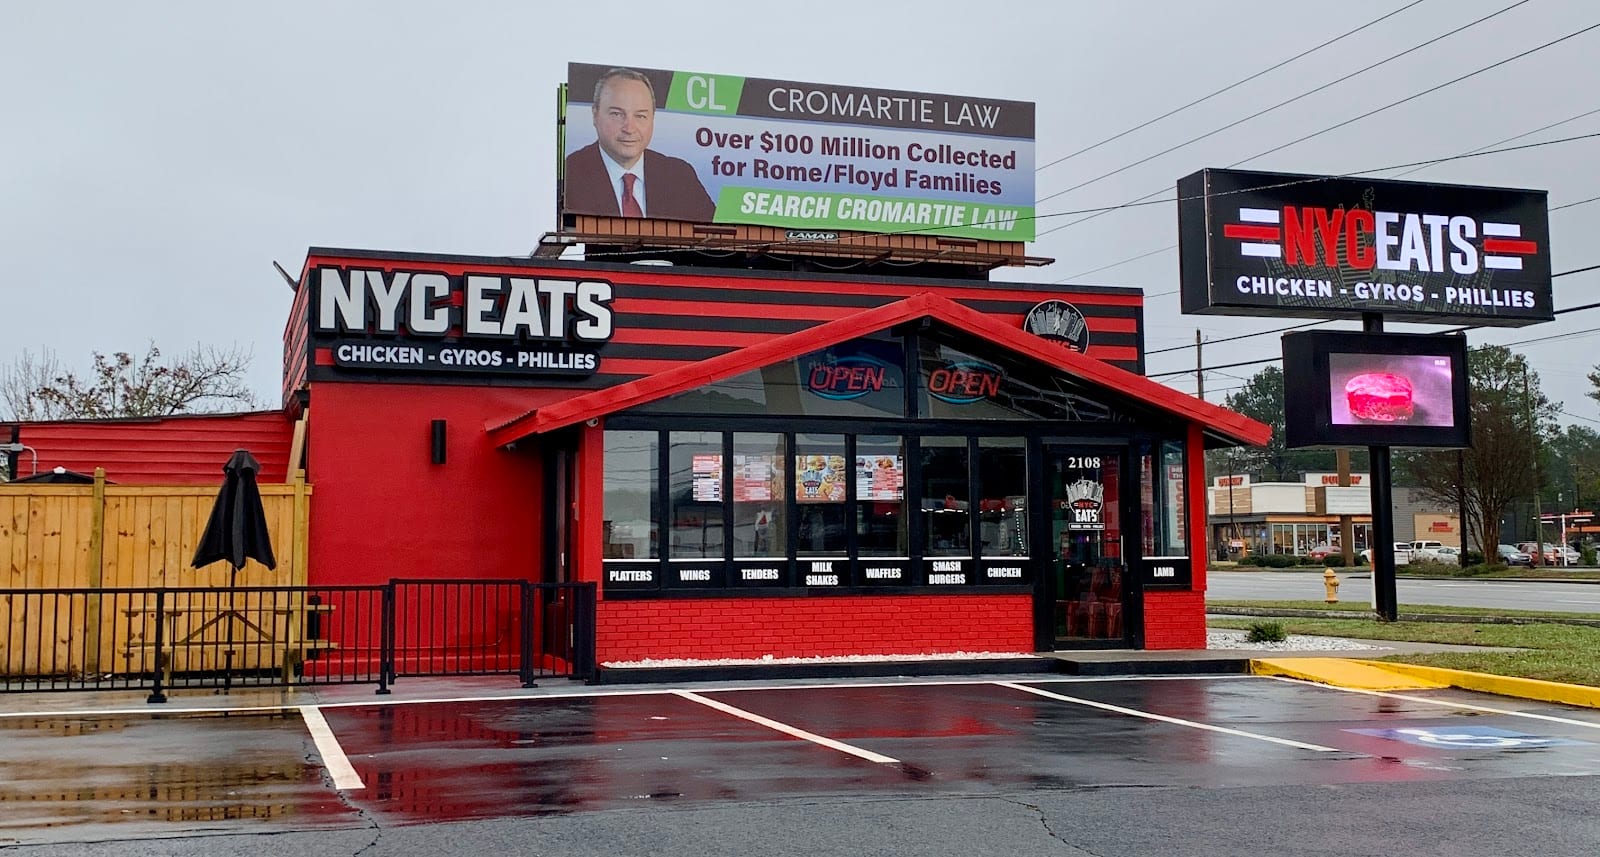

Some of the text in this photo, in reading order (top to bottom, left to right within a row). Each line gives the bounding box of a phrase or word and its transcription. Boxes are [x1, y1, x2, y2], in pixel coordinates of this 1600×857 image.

[686, 76, 727, 112] CL
[768, 87, 1001, 129] CROMARTIE LAW
[695, 126, 1017, 170] Over $100 Million Collected
[712, 154, 1002, 195] for Rome/Floyd Families
[741, 191, 1019, 231] SEARCH CROMARTIE LAW
[789, 232, 836, 241] LAMAR
[1236, 275, 1332, 298] CHICKEN
[1354, 282, 1425, 303] GYROS
[1446, 286, 1536, 308] PHILLIES
[318, 268, 613, 340] NYC EATS
[337, 344, 424, 364] CHICKEN
[440, 349, 502, 367] GYROS
[517, 352, 596, 370] PHILLIES
[809, 365, 885, 393] OPEN
[929, 368, 1001, 397] OPEN
[1068, 457, 1101, 469] 2108
[1075, 509, 1098, 522] EATS
[811, 562, 833, 573] MILK
[932, 561, 962, 572] SMASH
[1153, 567, 1175, 577] LAMB
[609, 571, 653, 582] PLATTERS
[680, 570, 711, 581] WINGS
[741, 569, 779, 580] TENDERS
[866, 568, 902, 579] WAFFLES
[928, 574, 966, 584] BURGERS
[987, 568, 1022, 578] CHICKEN
[805, 575, 839, 586] SHAKES
